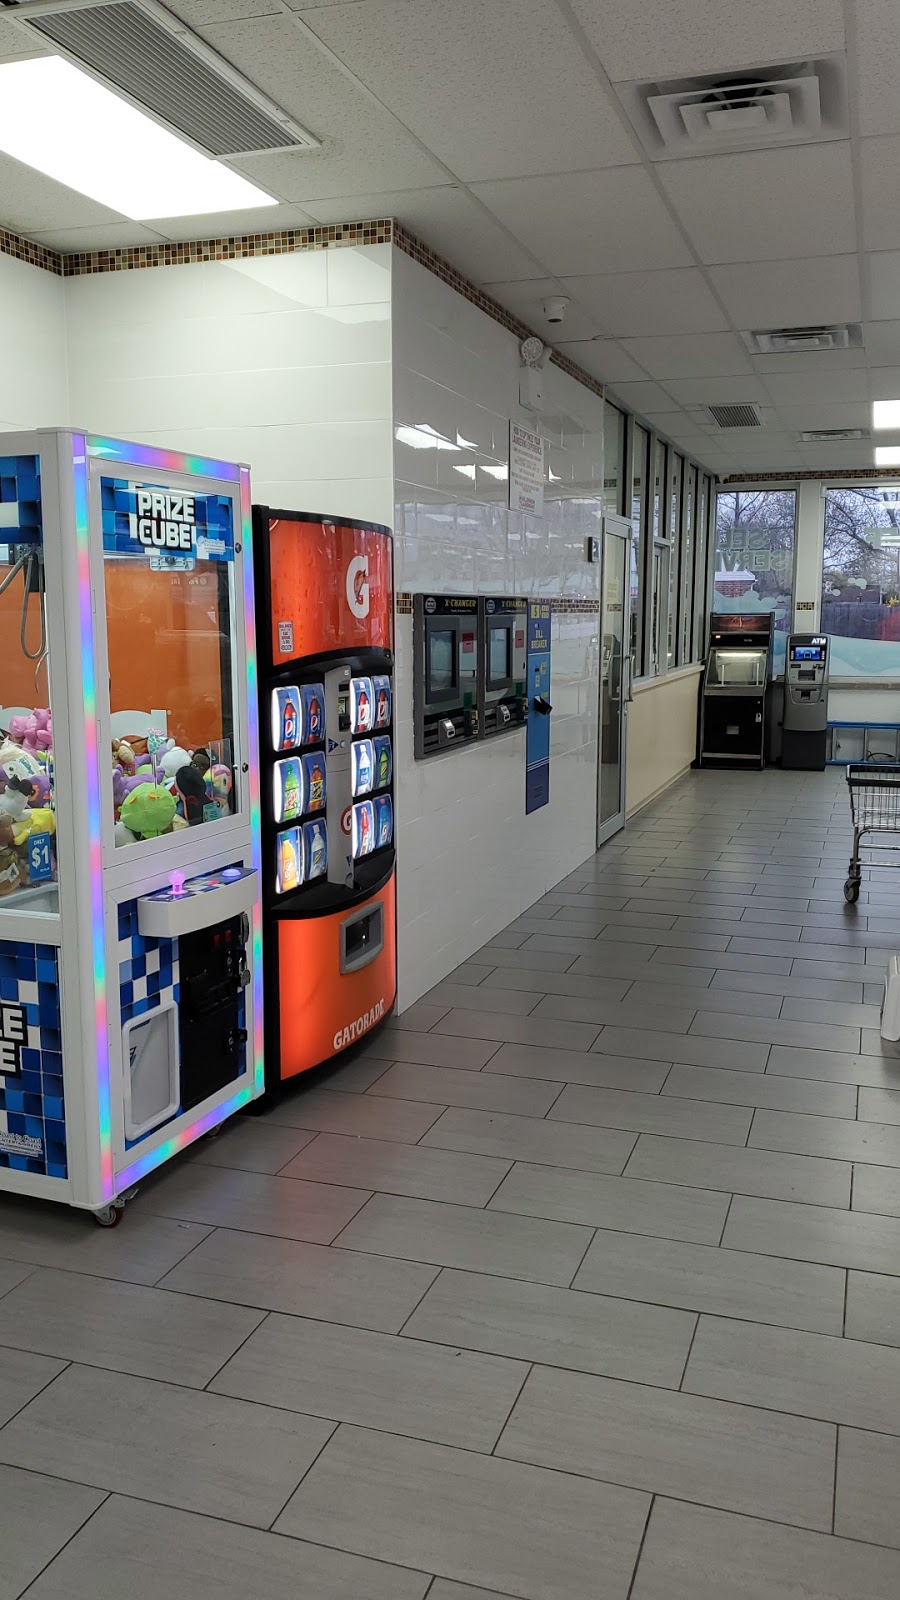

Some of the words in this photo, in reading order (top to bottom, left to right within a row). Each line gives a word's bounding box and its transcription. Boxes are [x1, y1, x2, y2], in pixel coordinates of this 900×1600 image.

[137, 490, 195, 523] PRIZE
[138, 518, 191, 549] CUBE
[345, 555, 370, 620] G
[811, 637, 827, 645] ATM
[31, 844, 49, 870] $1
[33, 838, 45, 846] ONLY
[333, 997, 384, 1050] GATORADE
